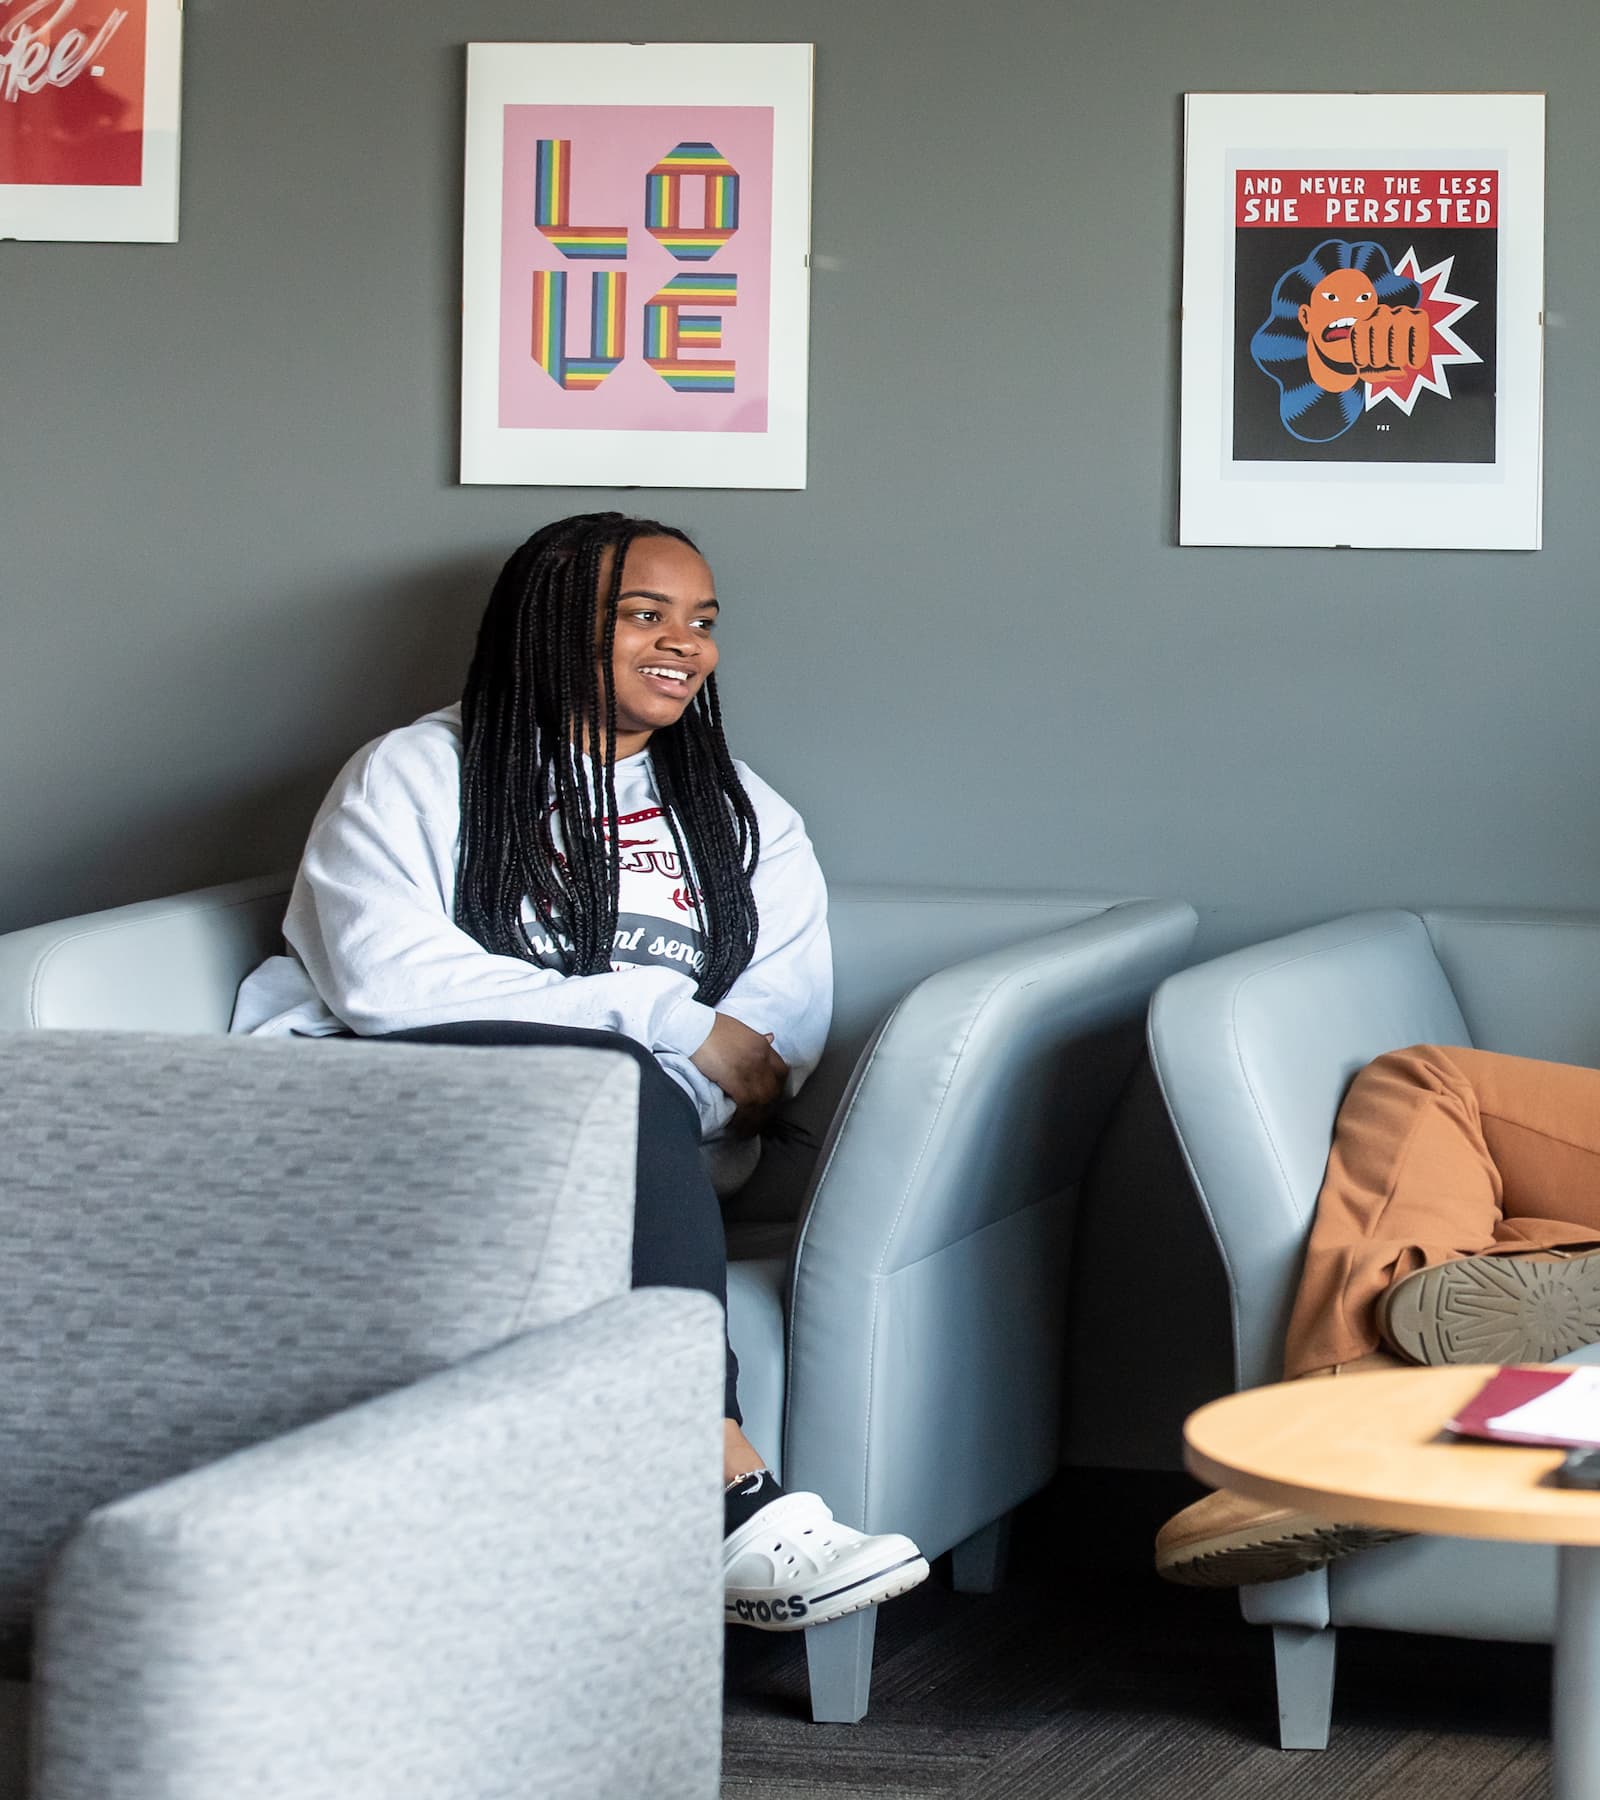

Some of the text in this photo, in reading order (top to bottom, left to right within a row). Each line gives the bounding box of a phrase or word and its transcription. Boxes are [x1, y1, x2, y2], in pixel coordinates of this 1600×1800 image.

[1244, 177, 1492, 195] AND NEVER THE LESS
[1244, 198, 1491, 224] SHE PERSISTED
[735, 1595, 808, 1622] crocs
